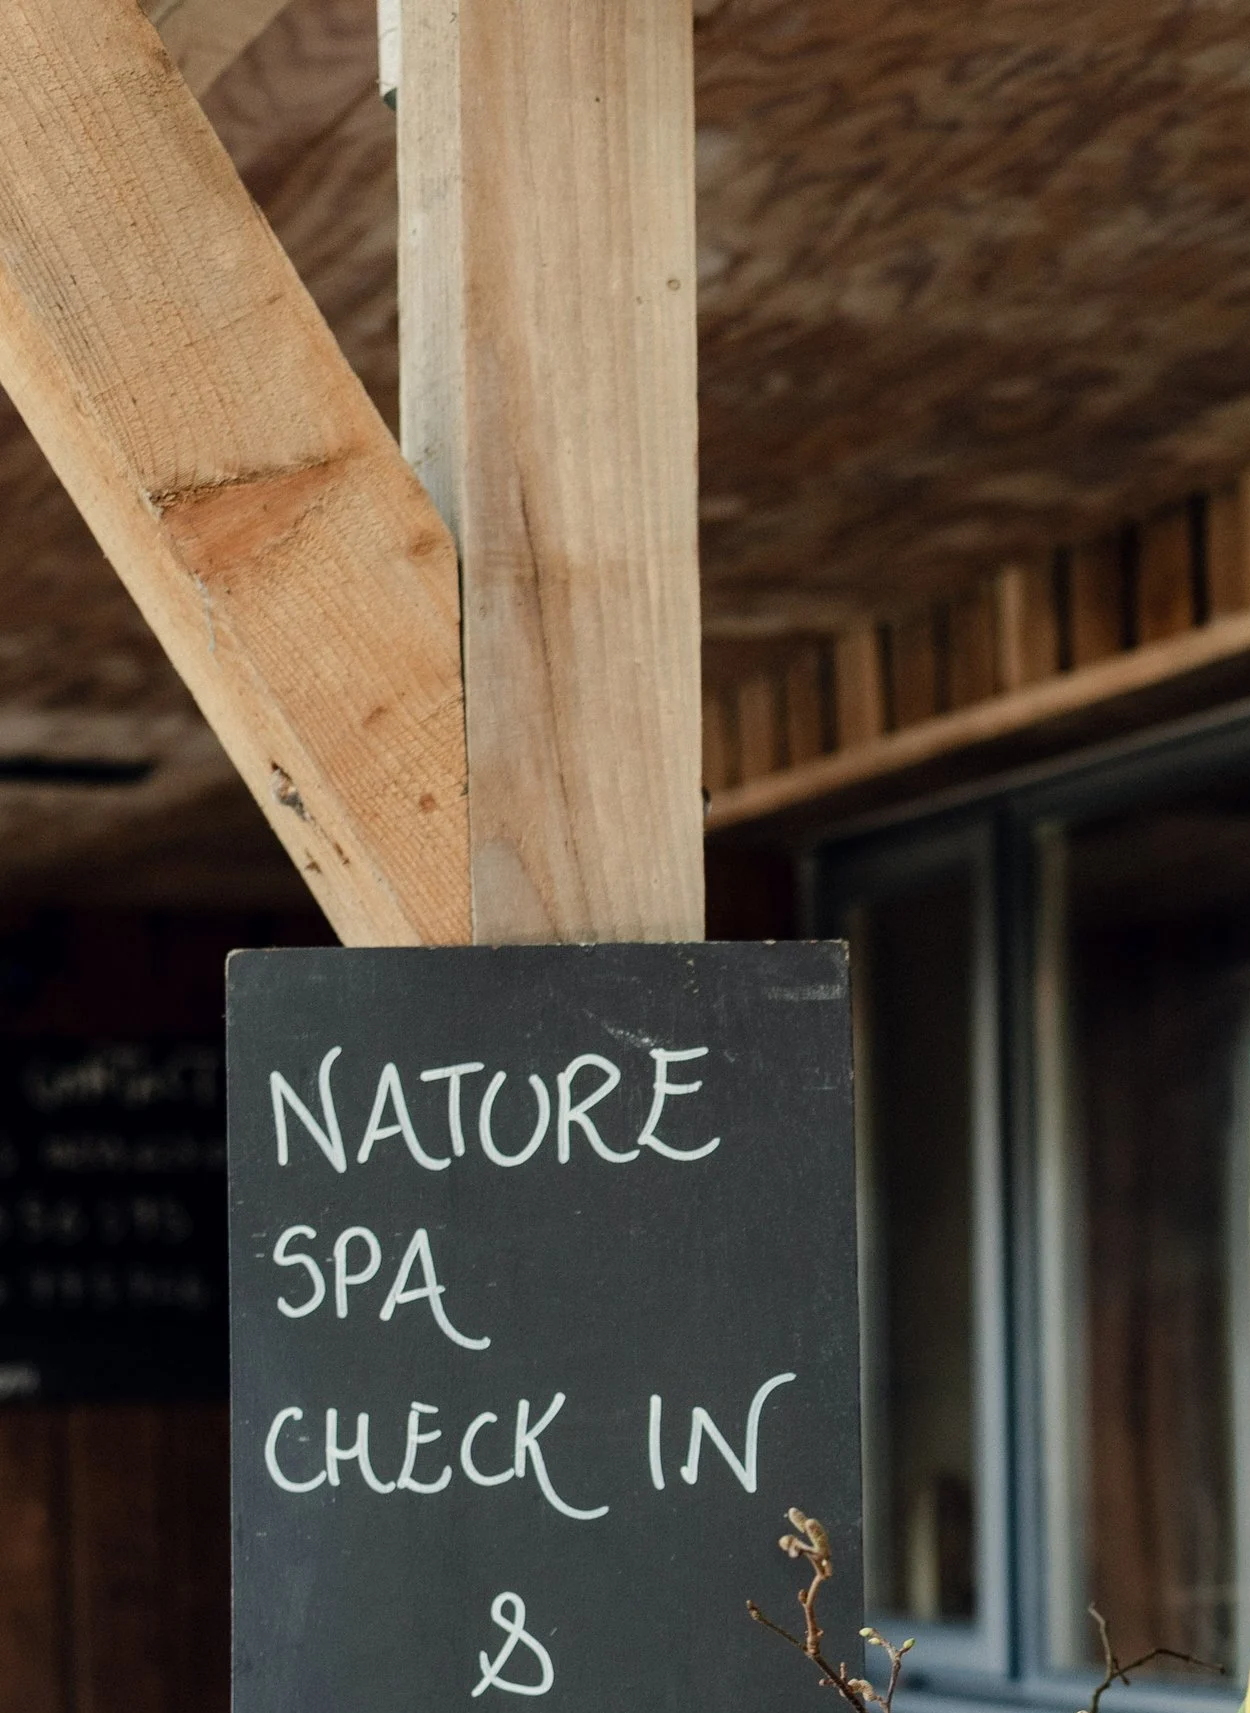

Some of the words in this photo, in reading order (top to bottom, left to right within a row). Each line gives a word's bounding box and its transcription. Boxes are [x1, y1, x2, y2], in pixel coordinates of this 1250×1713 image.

[268, 1045, 721, 1174] NATURE
[272, 1224, 492, 1351] SPA
[264, 1391, 610, 1520] CHECK
[648, 1372, 797, 1494] IN
[471, 1591, 555, 1698] &
